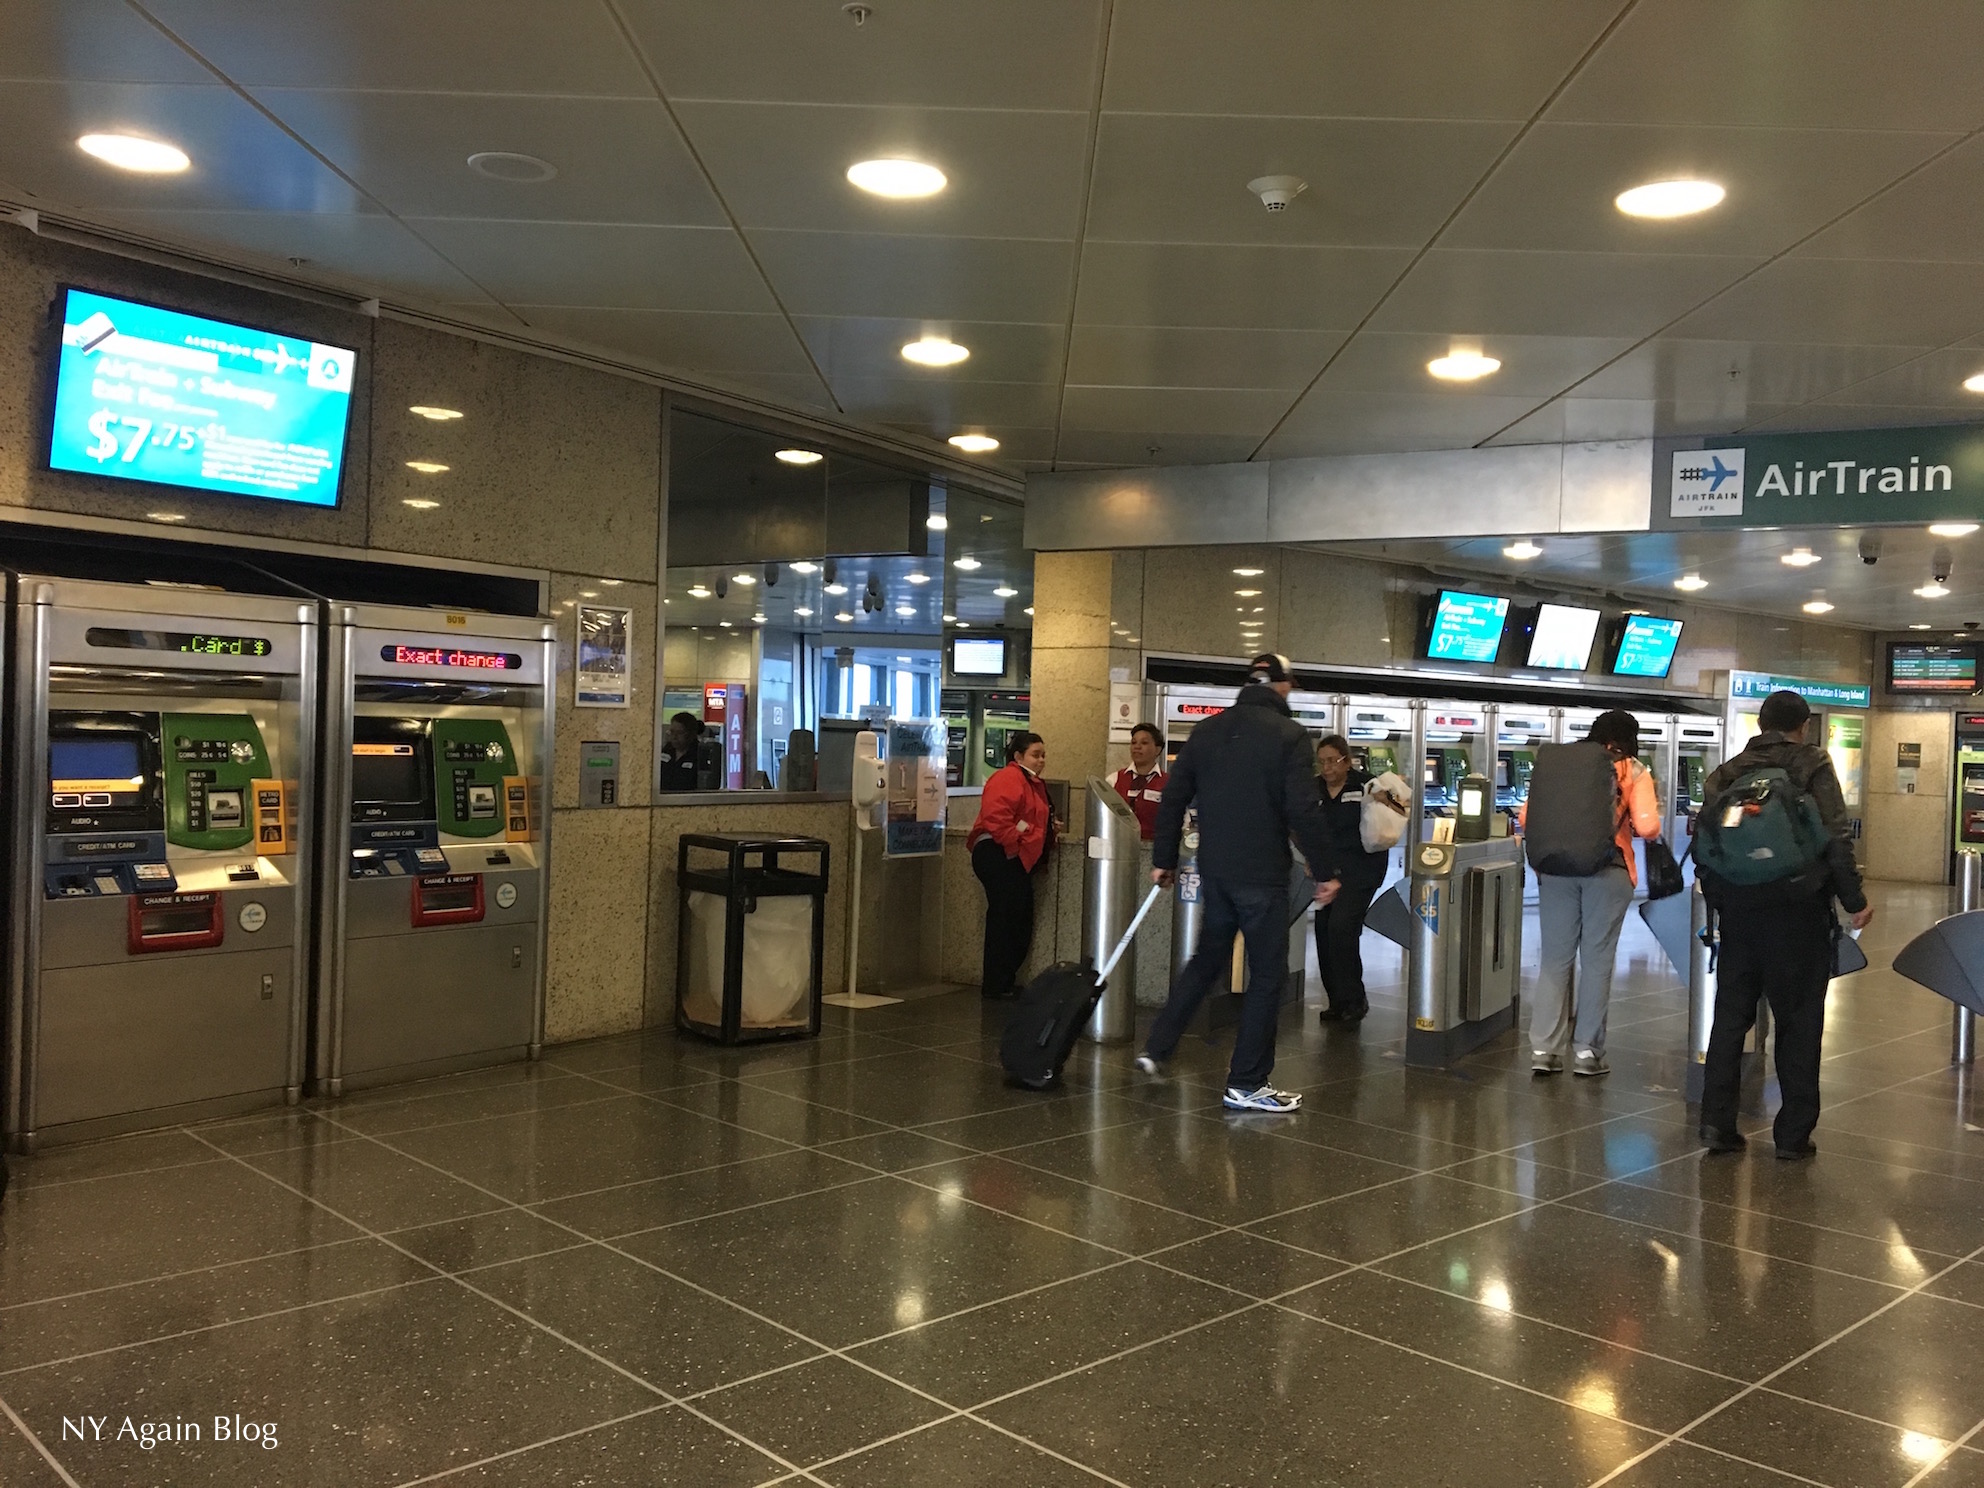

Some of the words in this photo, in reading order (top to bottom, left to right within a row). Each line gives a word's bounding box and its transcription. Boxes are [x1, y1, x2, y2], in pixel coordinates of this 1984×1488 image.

[1755, 456, 1952, 498] AirTrain
[1678, 492, 1738, 502] AIRTRAIN
[395, 646, 443, 664] Exact
[448, 650, 506, 668] change
[1756, 681, 1770, 692] Train
[1801, 687, 1807, 695] to
[1807, 686, 1834, 698] Manhattan
[1839, 689, 1850, 701] Long
[1850, 689, 1865, 700] Island
[729, 713, 741, 773] ATM
[71, 817, 92, 825] AUDIO
[118, 841, 136, 849] CARD
[424, 877, 446, 885] CHANGE
[144, 896, 172, 906] CHANGE
[182, 894, 210, 903] RECEIPT
